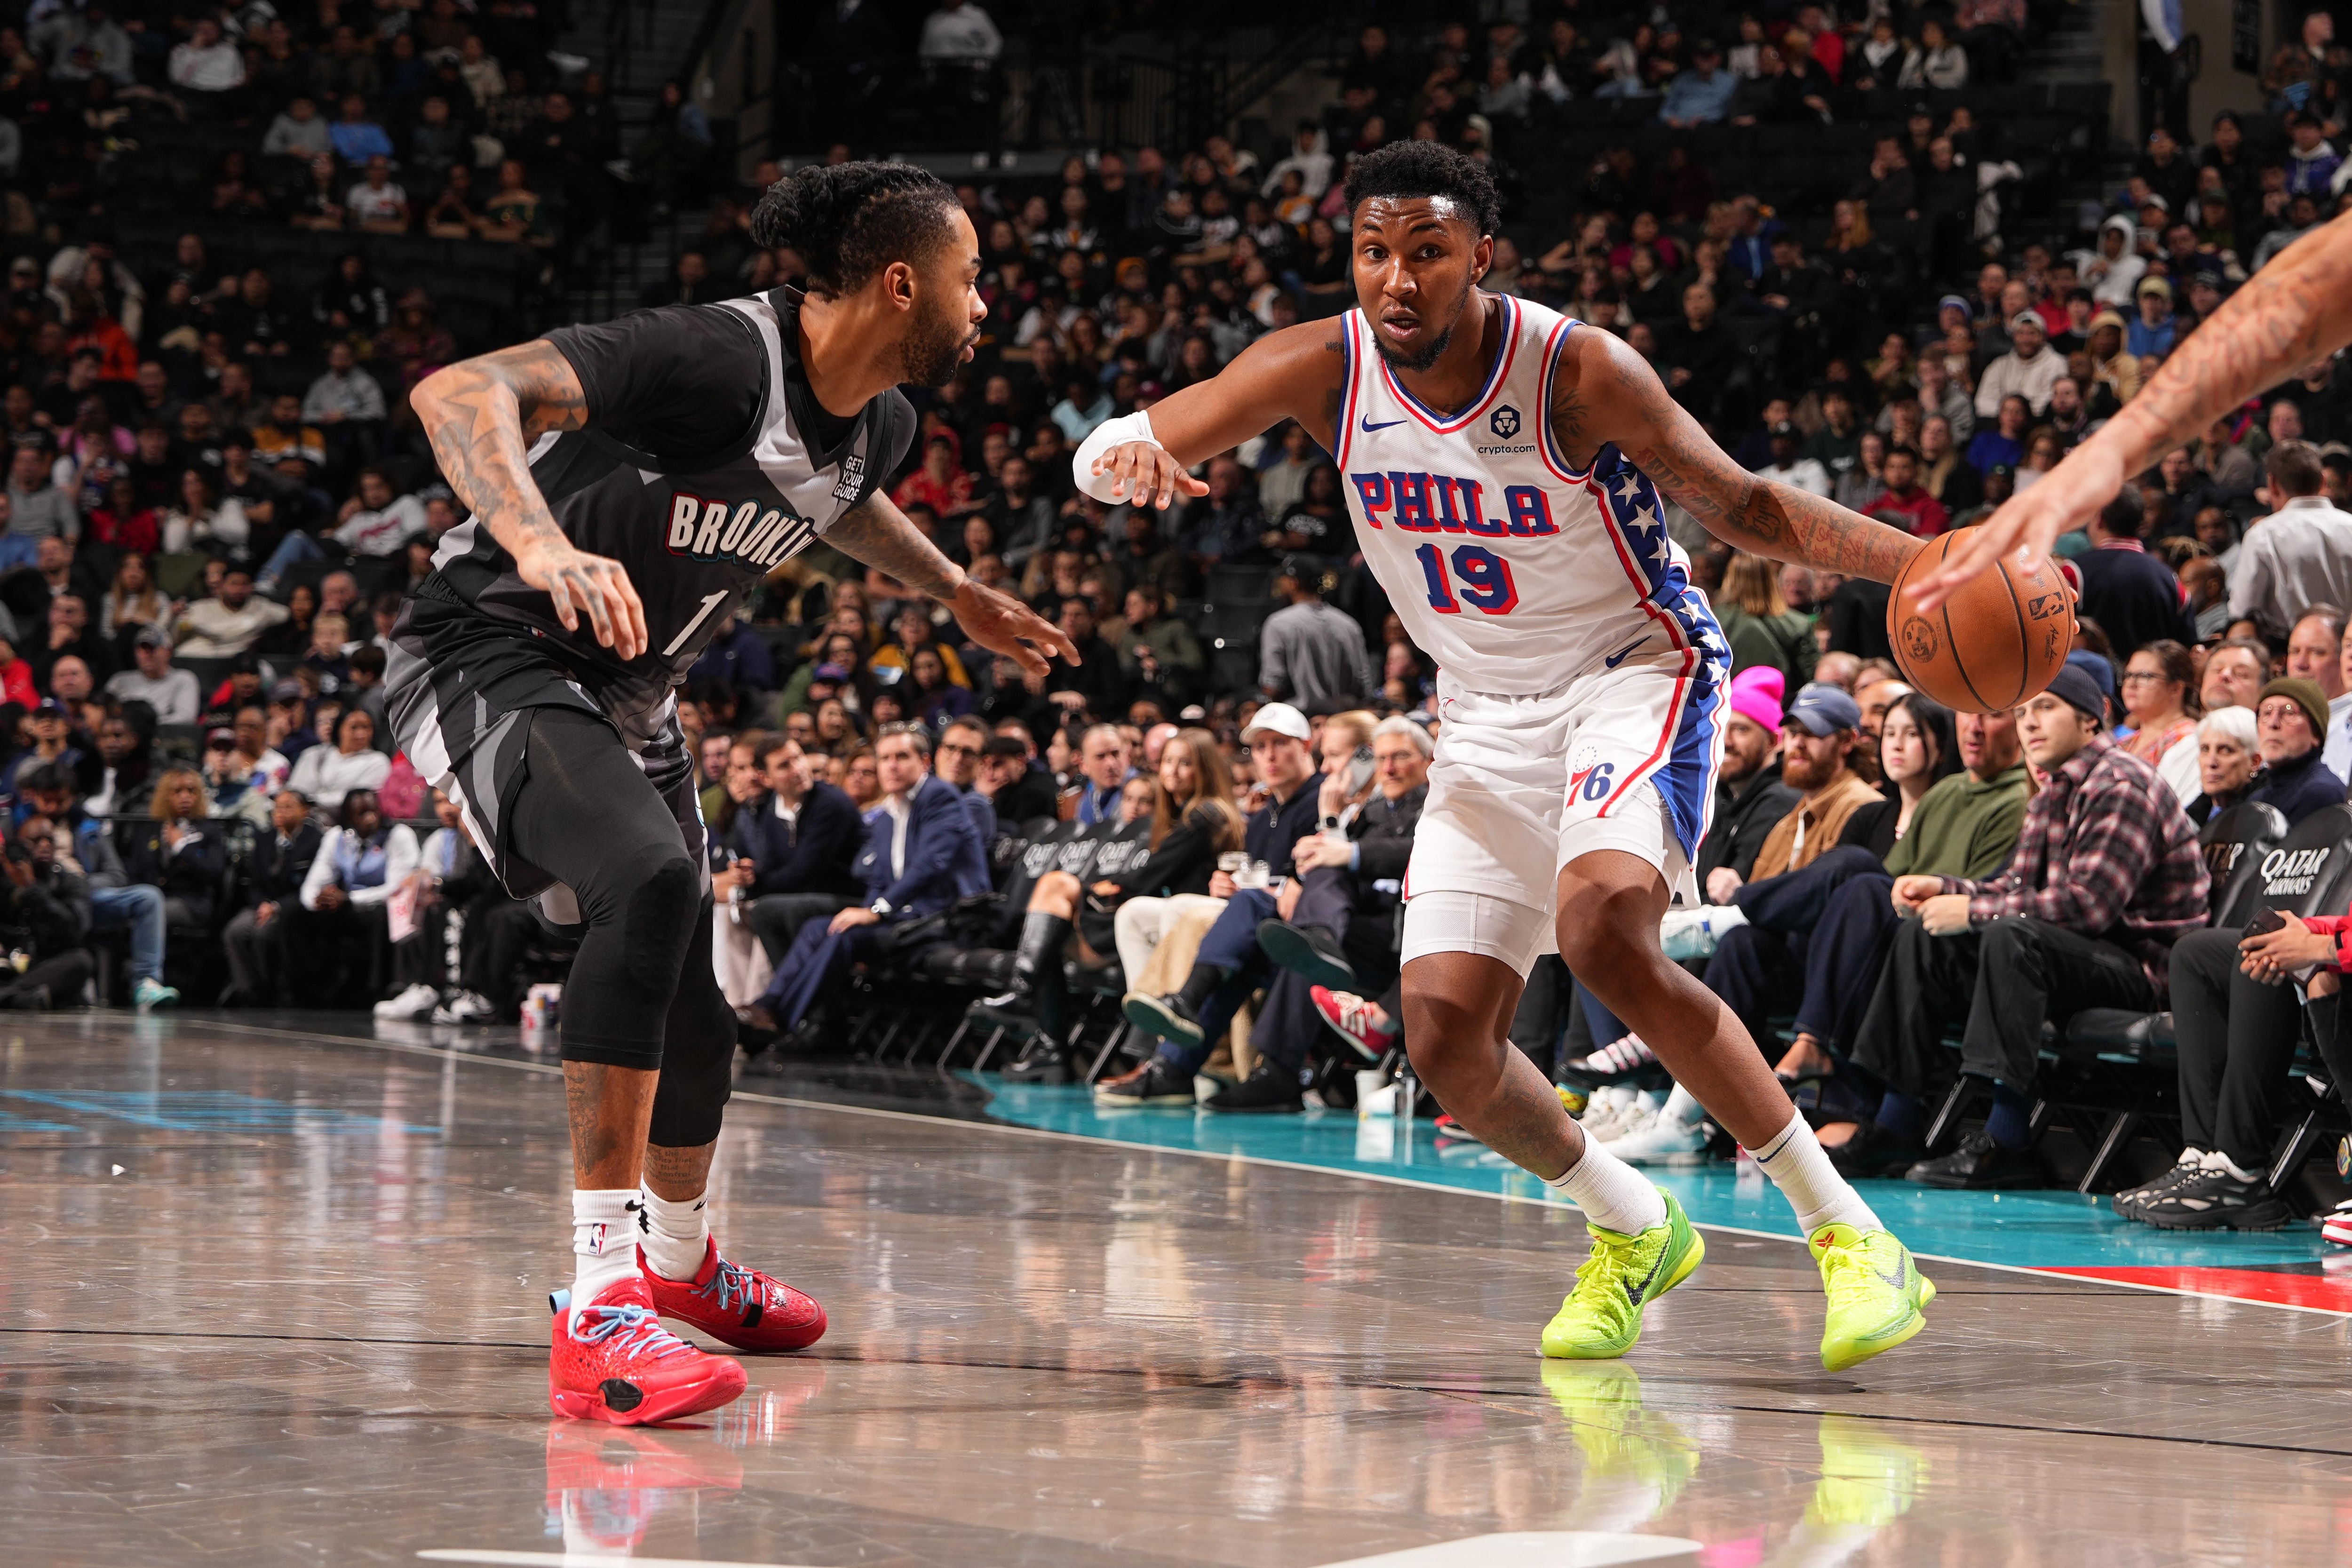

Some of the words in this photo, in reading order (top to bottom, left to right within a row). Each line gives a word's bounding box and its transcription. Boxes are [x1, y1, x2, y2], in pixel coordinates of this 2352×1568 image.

[846, 455, 862, 472] GET
[1478, 445, 1535, 455] crypto.com
[834, 483, 860, 501] GUIDE
[842, 469, 864, 488] YOUR
[1350, 471, 1560, 538] PHILA
[666, 493, 816, 574] BROOKLY
[1415, 543, 1519, 614] 19
[662, 589, 730, 656] 1
[1565, 762, 1614, 810] 76
[2260, 847, 2330, 884] QATAR
[2263, 875, 2315, 896] AIRWAYS
